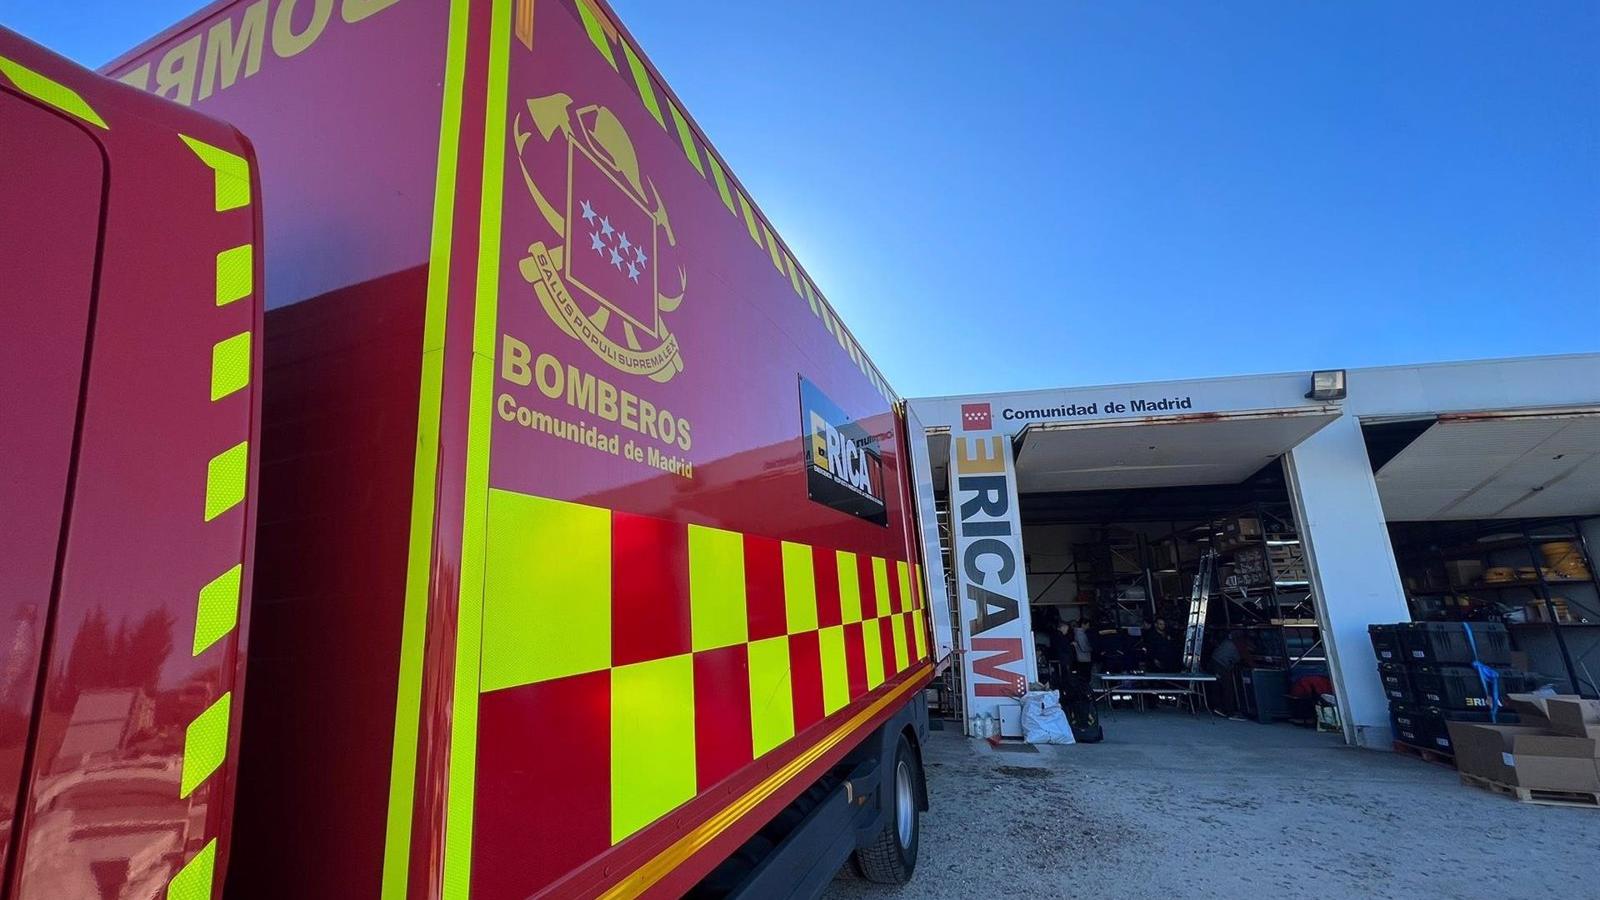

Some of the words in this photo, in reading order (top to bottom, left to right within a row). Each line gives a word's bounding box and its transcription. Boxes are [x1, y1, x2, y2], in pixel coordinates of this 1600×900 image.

[537, 253, 574, 316] SALUS
[573, 316, 618, 361] POPULI
[617, 352, 665, 369] SUPREMA
[662, 339, 677, 360] LEX
[497, 393, 619, 456] Comunidad
[624, 439, 644, 463] de
[648, 447, 693, 479] Madrid
[502, 334, 692, 451] BOMBEROS
[1002, 402, 1098, 420] Comunidad
[1104, 401, 1126, 414] de
[1130, 396, 1193, 413] Madrid
[956, 435, 1027, 698] ERICAM
